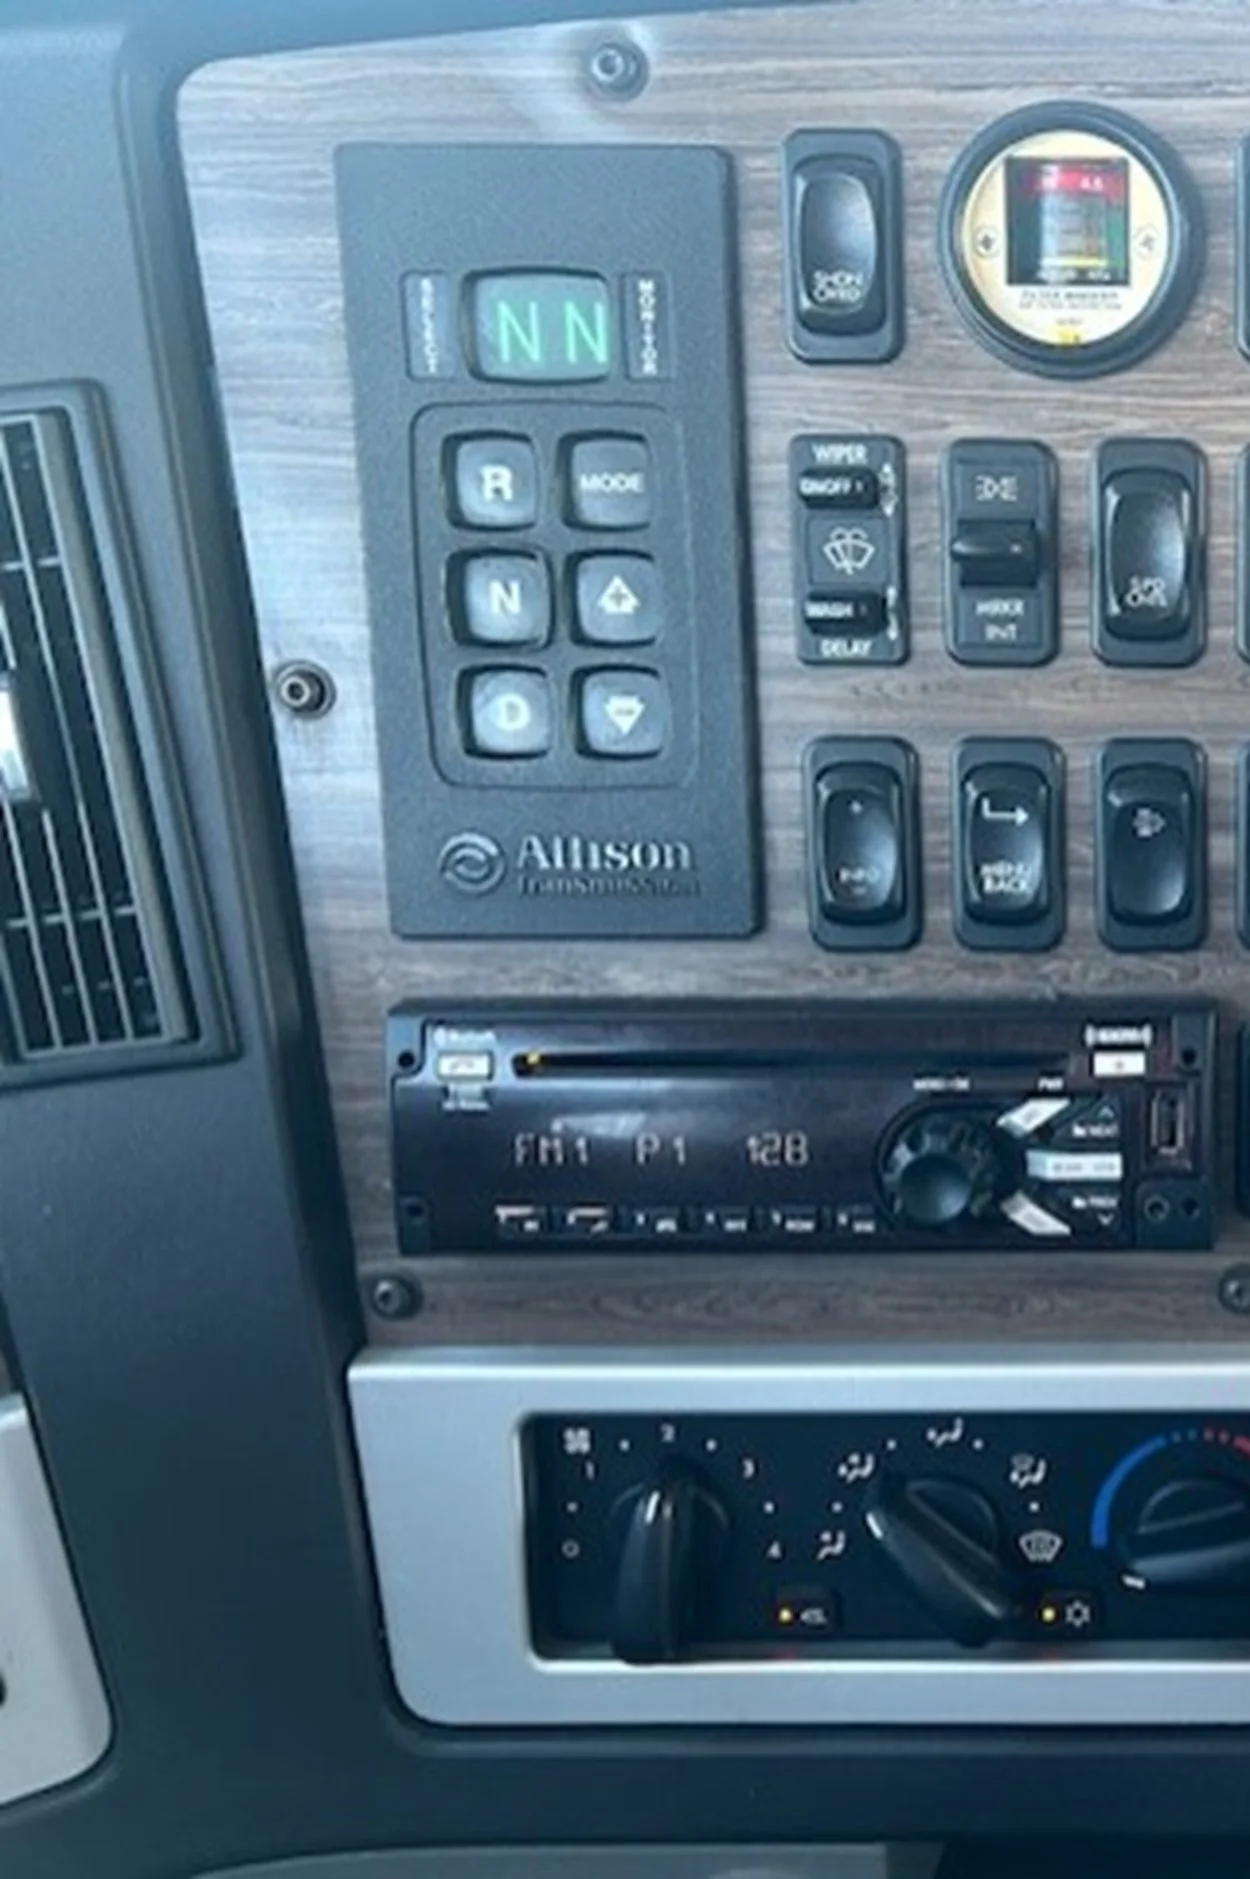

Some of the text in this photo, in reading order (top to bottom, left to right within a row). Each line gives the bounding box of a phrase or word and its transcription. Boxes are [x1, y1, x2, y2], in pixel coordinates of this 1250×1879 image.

[812, 443, 868, 465] WIPER
[480, 464, 514, 502] R
[580, 472, 645, 494] MODE
[488, 580, 521, 615] N
[819, 639, 873, 658] DELAY
[497, 694, 531, 732] D
[517, 834, 692, 871] Allison
[747, 1131, 809, 1167] 128
[659, 1423, 676, 1443] 2
[584, 1460, 596, 1480] 1
